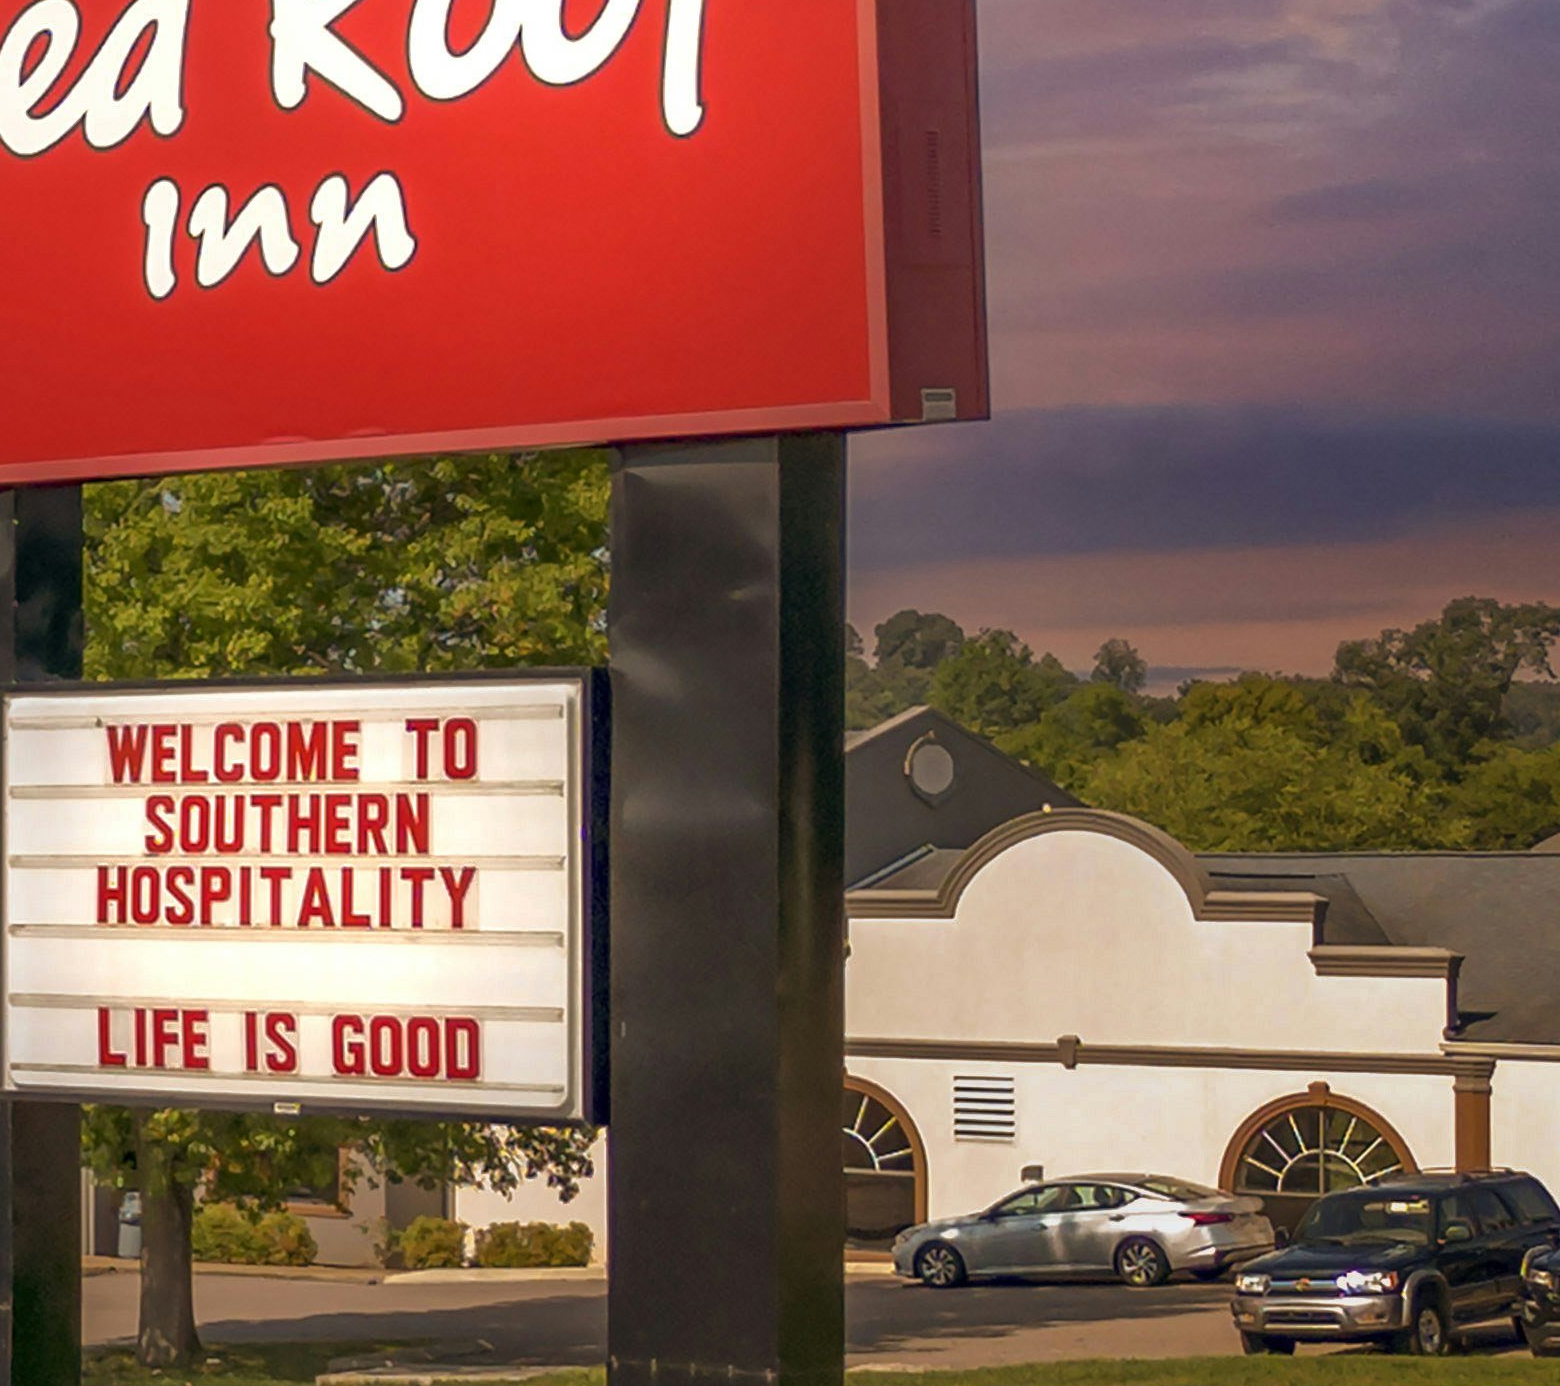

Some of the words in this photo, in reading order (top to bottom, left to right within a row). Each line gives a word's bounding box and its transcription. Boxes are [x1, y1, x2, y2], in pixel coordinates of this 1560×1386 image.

[107, 719, 360, 785] WELCOME
[405, 716, 478, 781] TO
[145, 792, 430, 857] SOUTHERN
[96, 865, 476, 931] HOSPITALITY
[97, 1007, 209, 1071] LIFE
[244, 1011, 298, 1074] IS
[331, 1013, 480, 1081] GOOD
